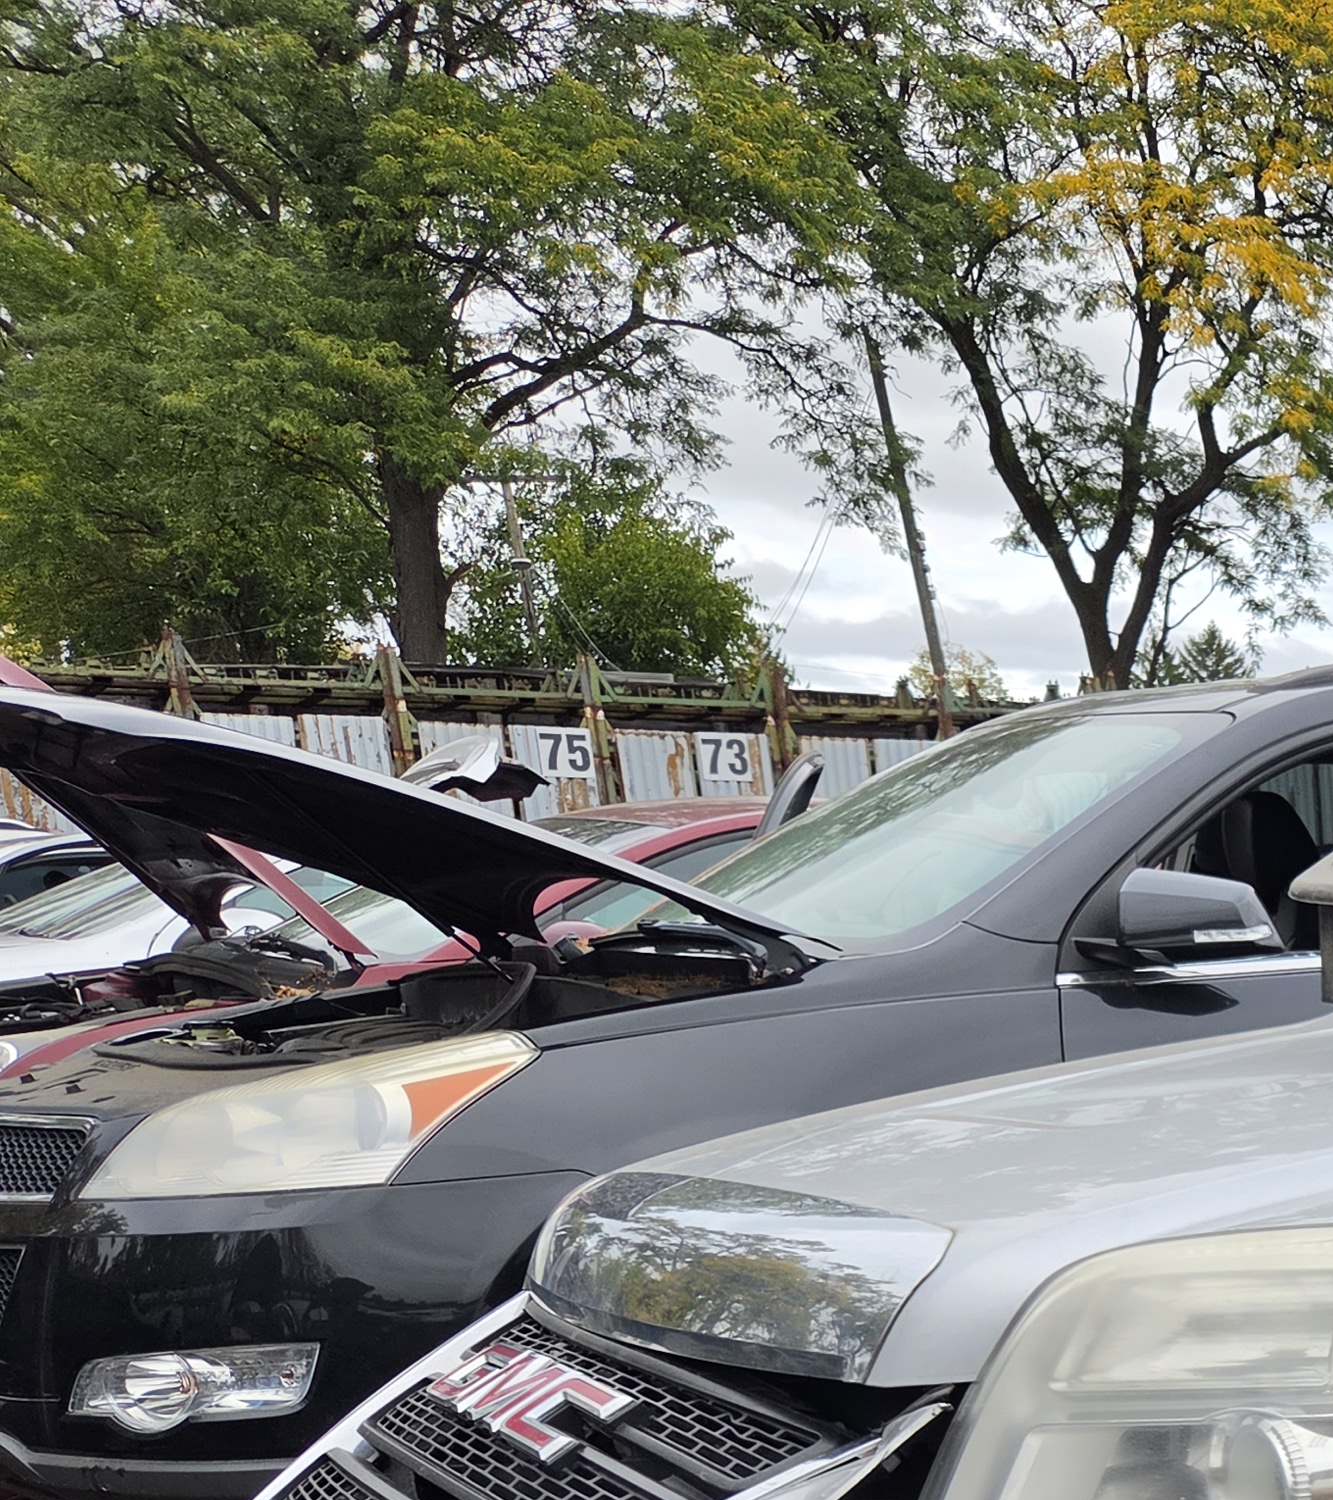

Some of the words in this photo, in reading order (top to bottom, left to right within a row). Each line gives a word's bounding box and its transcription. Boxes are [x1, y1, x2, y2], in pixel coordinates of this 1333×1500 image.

[538, 732, 591, 772] 75
[701, 738, 748, 776] 73
[426, 1344, 636, 1463] GMC
